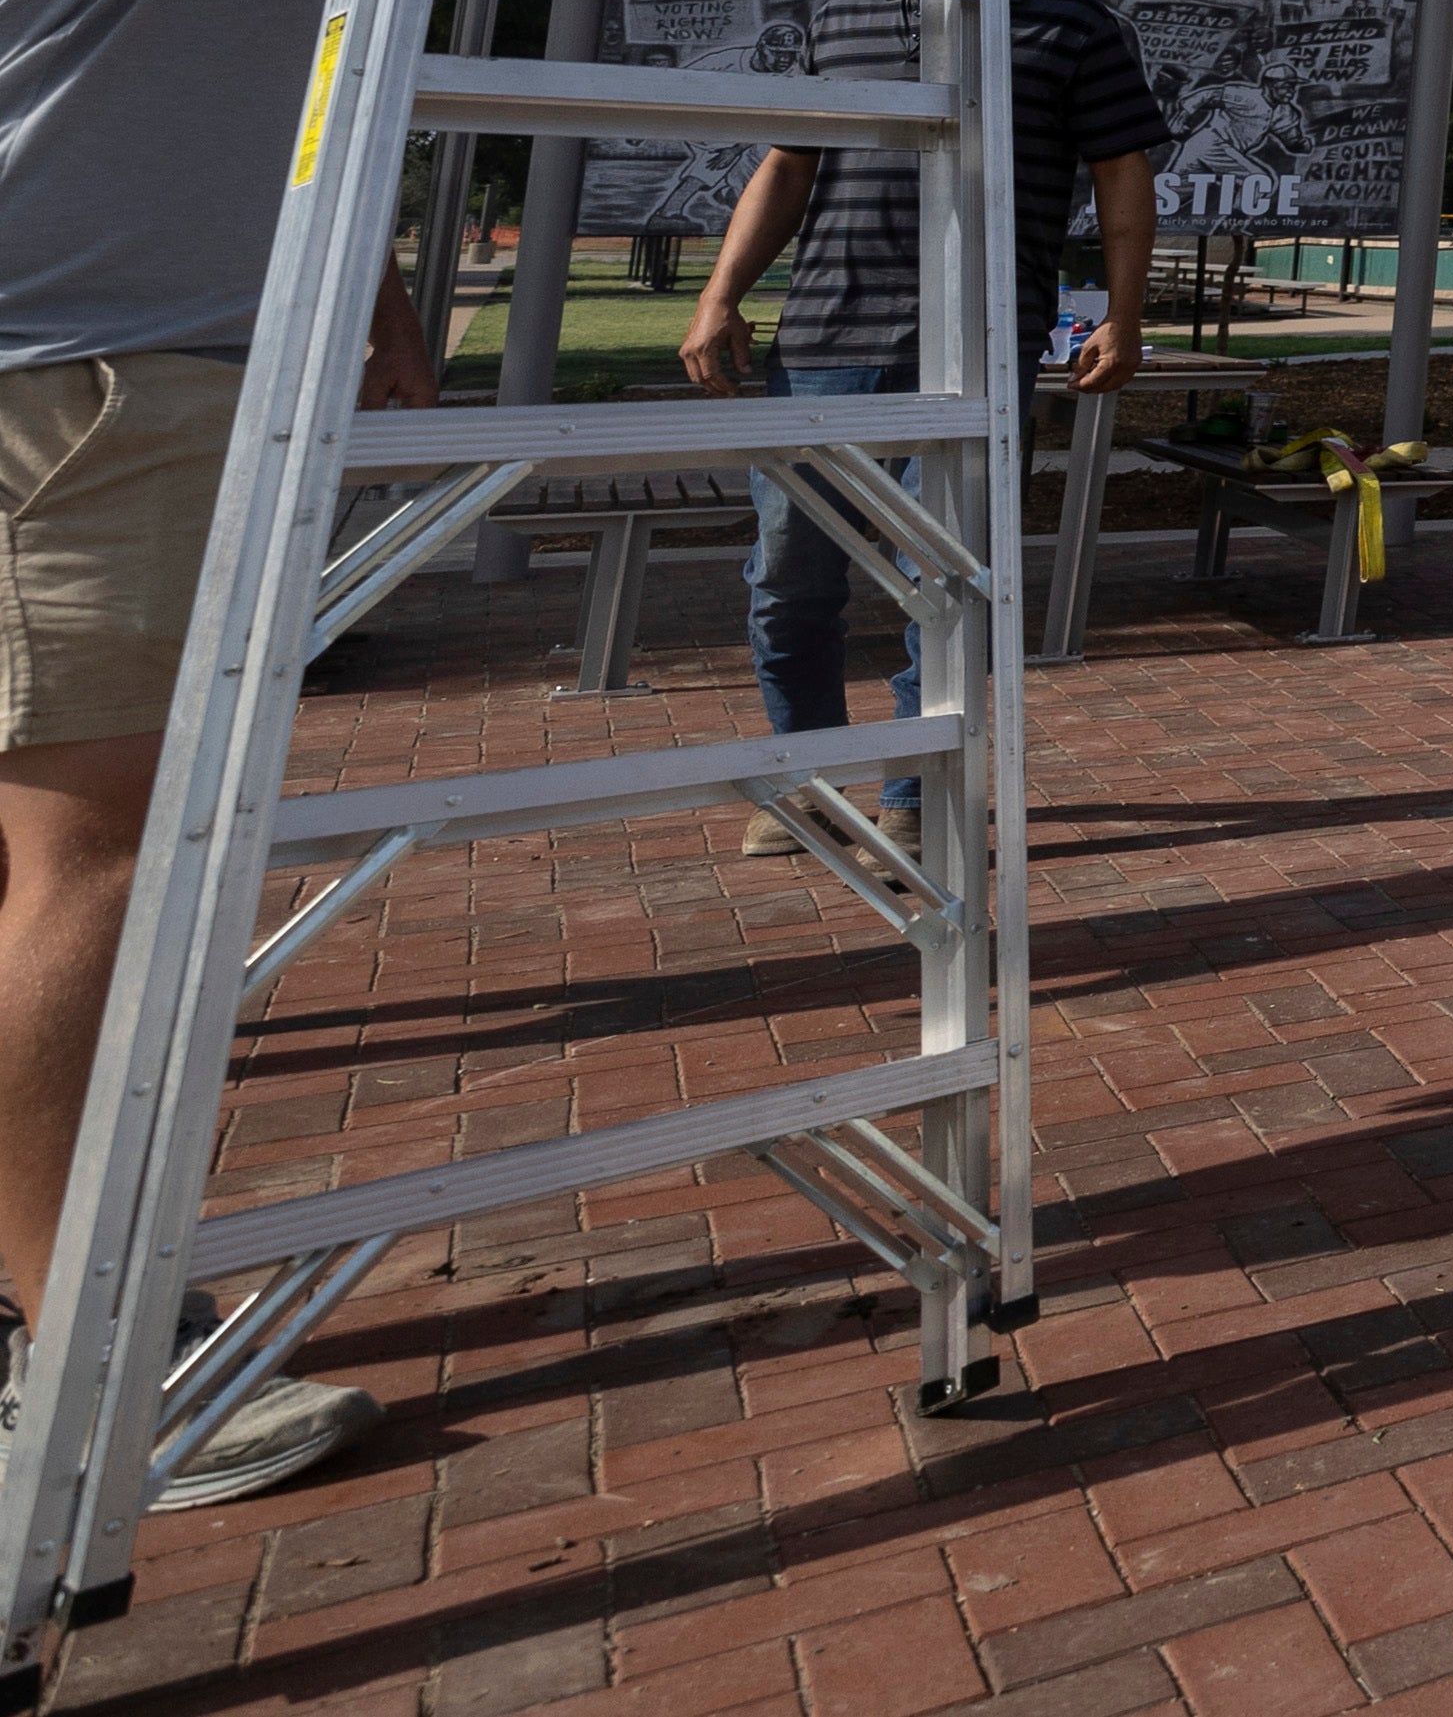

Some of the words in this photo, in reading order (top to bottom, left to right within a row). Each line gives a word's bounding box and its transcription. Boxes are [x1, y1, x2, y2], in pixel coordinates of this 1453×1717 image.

[654, 0, 737, 15] VOTING
[656, 15, 733, 31] RIGHTS
[1137, 9, 1235, 28] DEMAND
[662, 27, 724, 42] NOW!
[1138, 23, 1217, 40] DECENT
[1284, 27, 1378, 46] DEMAND
[1140, 35, 1221, 56] HOUSING
[1286, 45, 1323, 59] AN
[1329, 43, 1373, 57] END
[1293, 56, 1322, 69] TO
[1324, 55, 1371, 70] BIAS
[1351, 104, 1382, 120] WE
[1324, 143, 1403, 162] EQUAL
[1304, 160, 1401, 184] RIGHTS
[1086, 172, 1301, 216] STICE
[1324, 183, 1392, 202] NOW!
[1157, 216, 1188, 228] fairly
[1191, 218, 1207, 226] no
[1254, 217, 1279, 226] who
[1282, 217, 1308, 228] they
[1311, 218, 1329, 226] are
